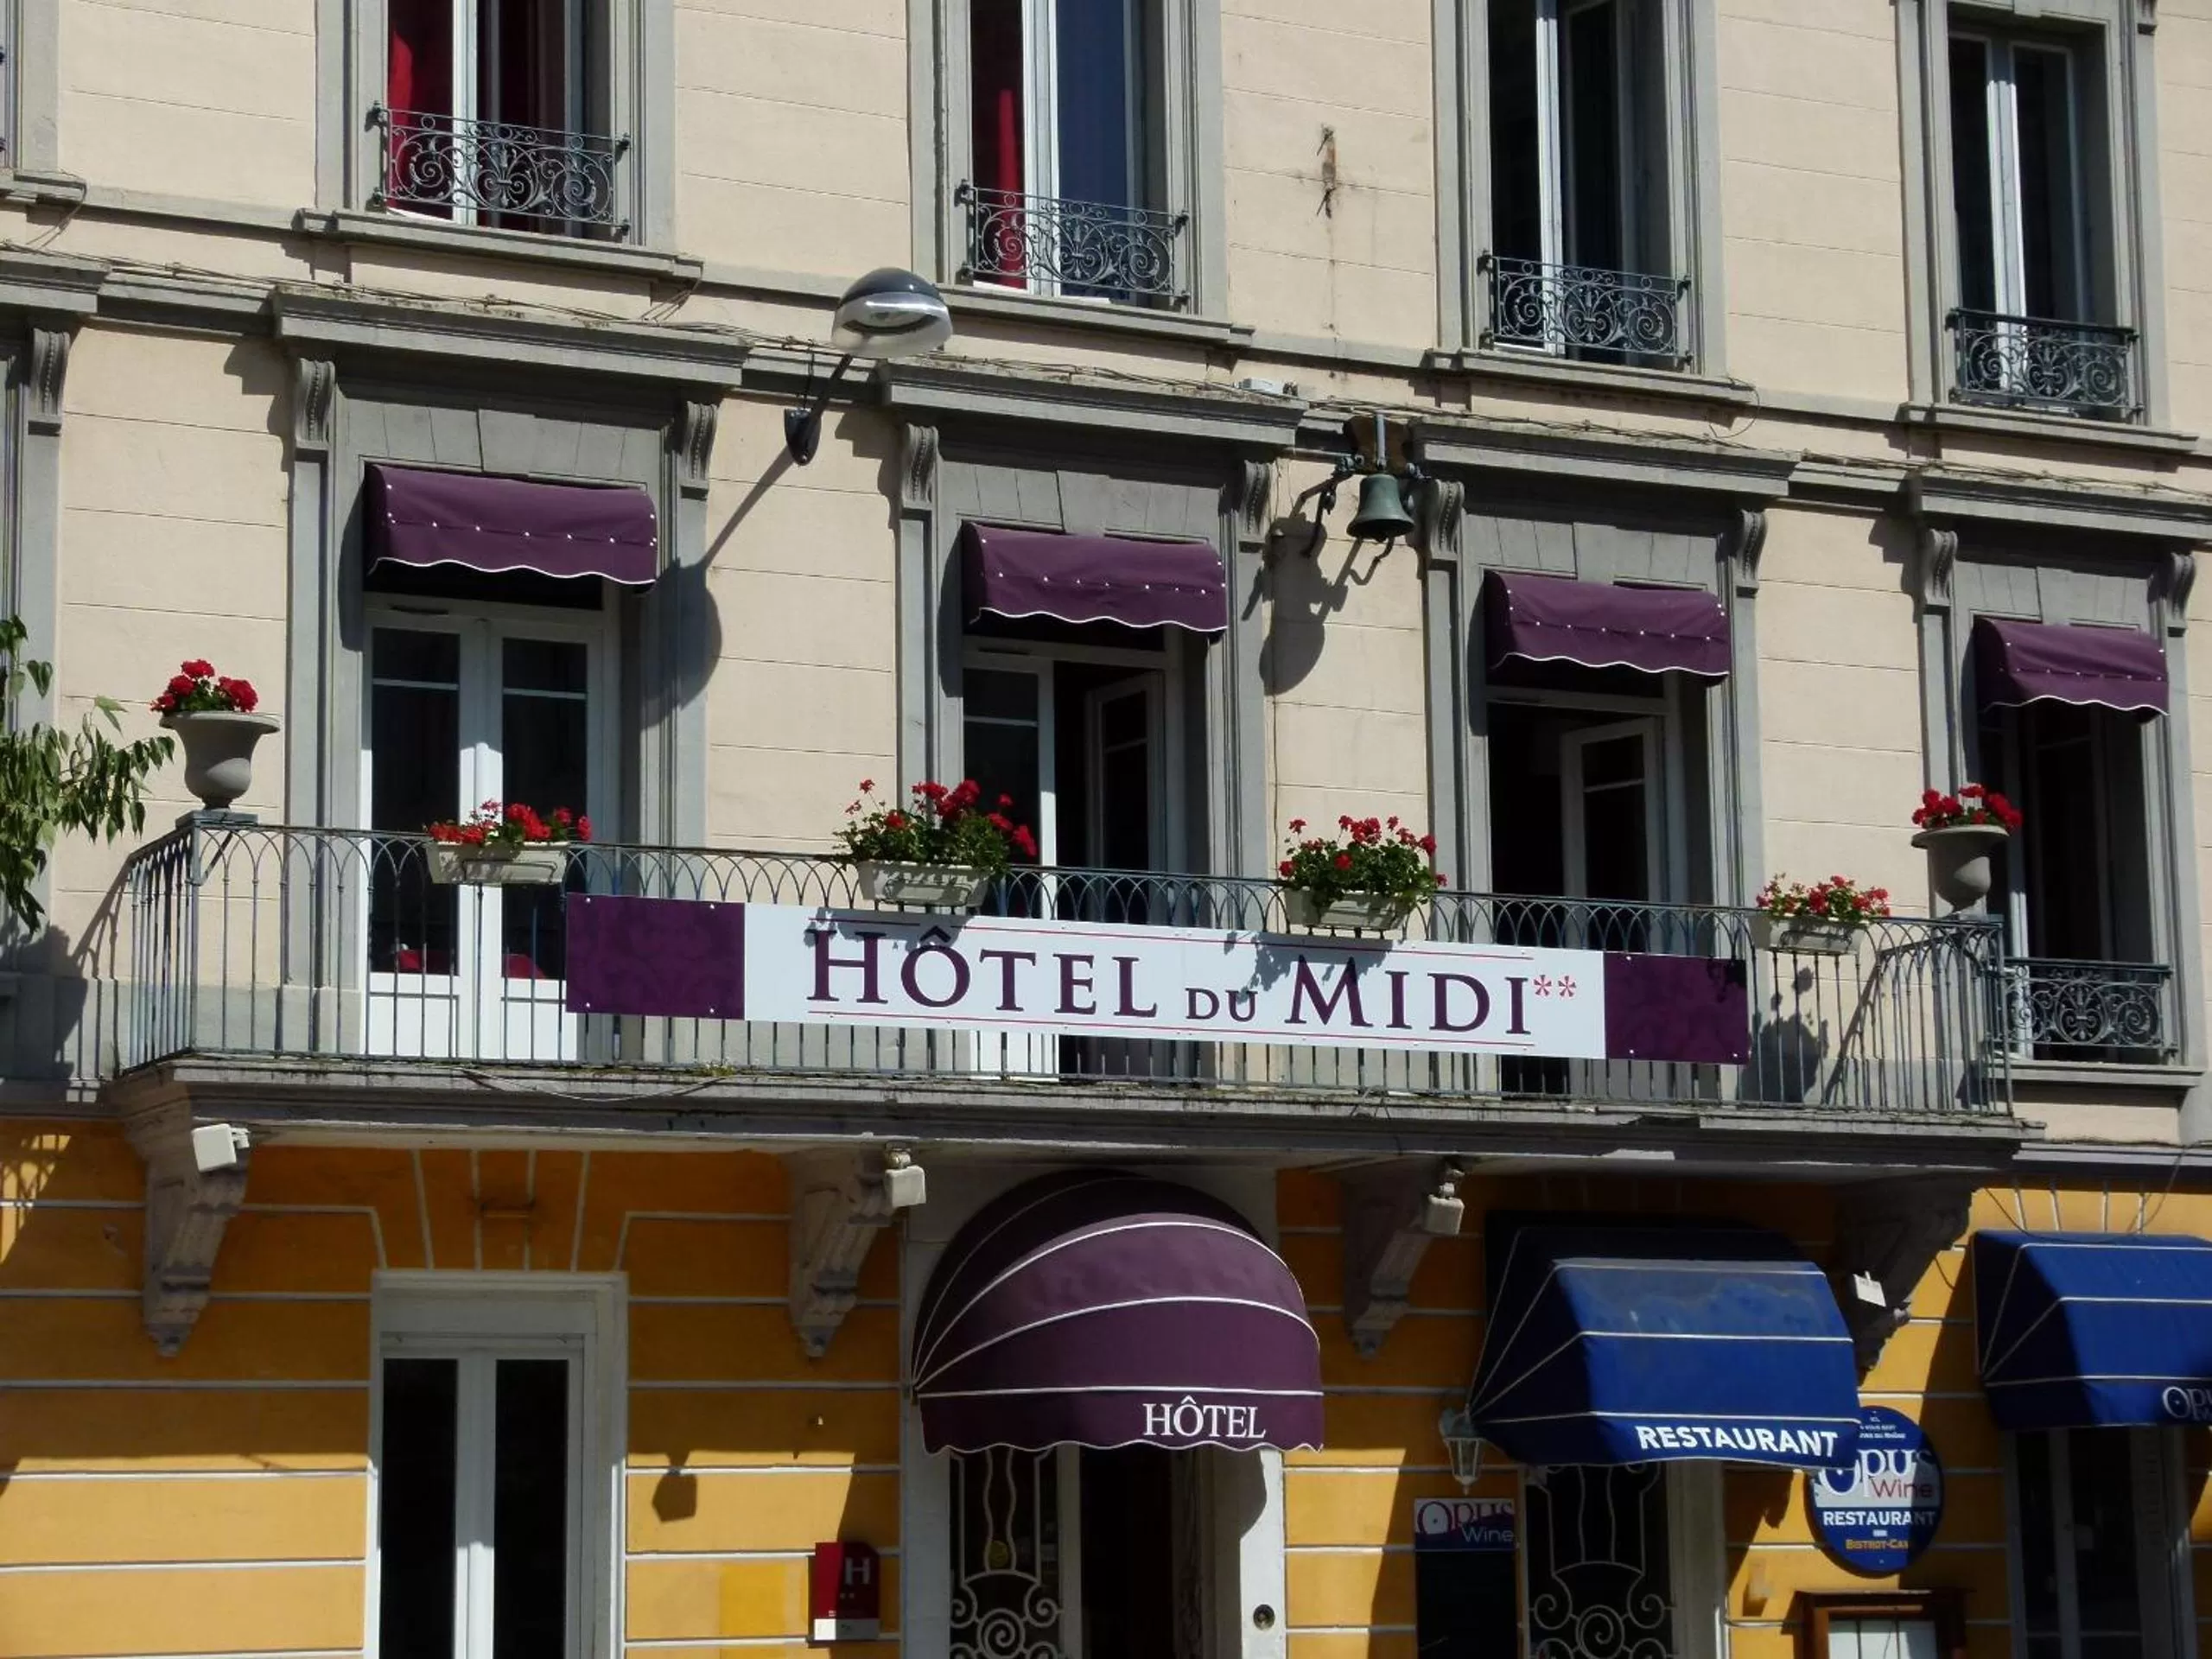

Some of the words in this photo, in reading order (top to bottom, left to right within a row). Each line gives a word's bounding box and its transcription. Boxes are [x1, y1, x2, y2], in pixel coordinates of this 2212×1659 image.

[807, 925, 1158, 1018] HÔTEL
[1142, 1395, 1267, 1439] HÔTEL
[1636, 1426, 1839, 1458] RESTAURANT
[1871, 1478, 1934, 1498] Wine
[1822, 1510, 1936, 1527] RESTAURANT
[1462, 1526, 1514, 1542] Wine
[844, 1557, 870, 1585] H
